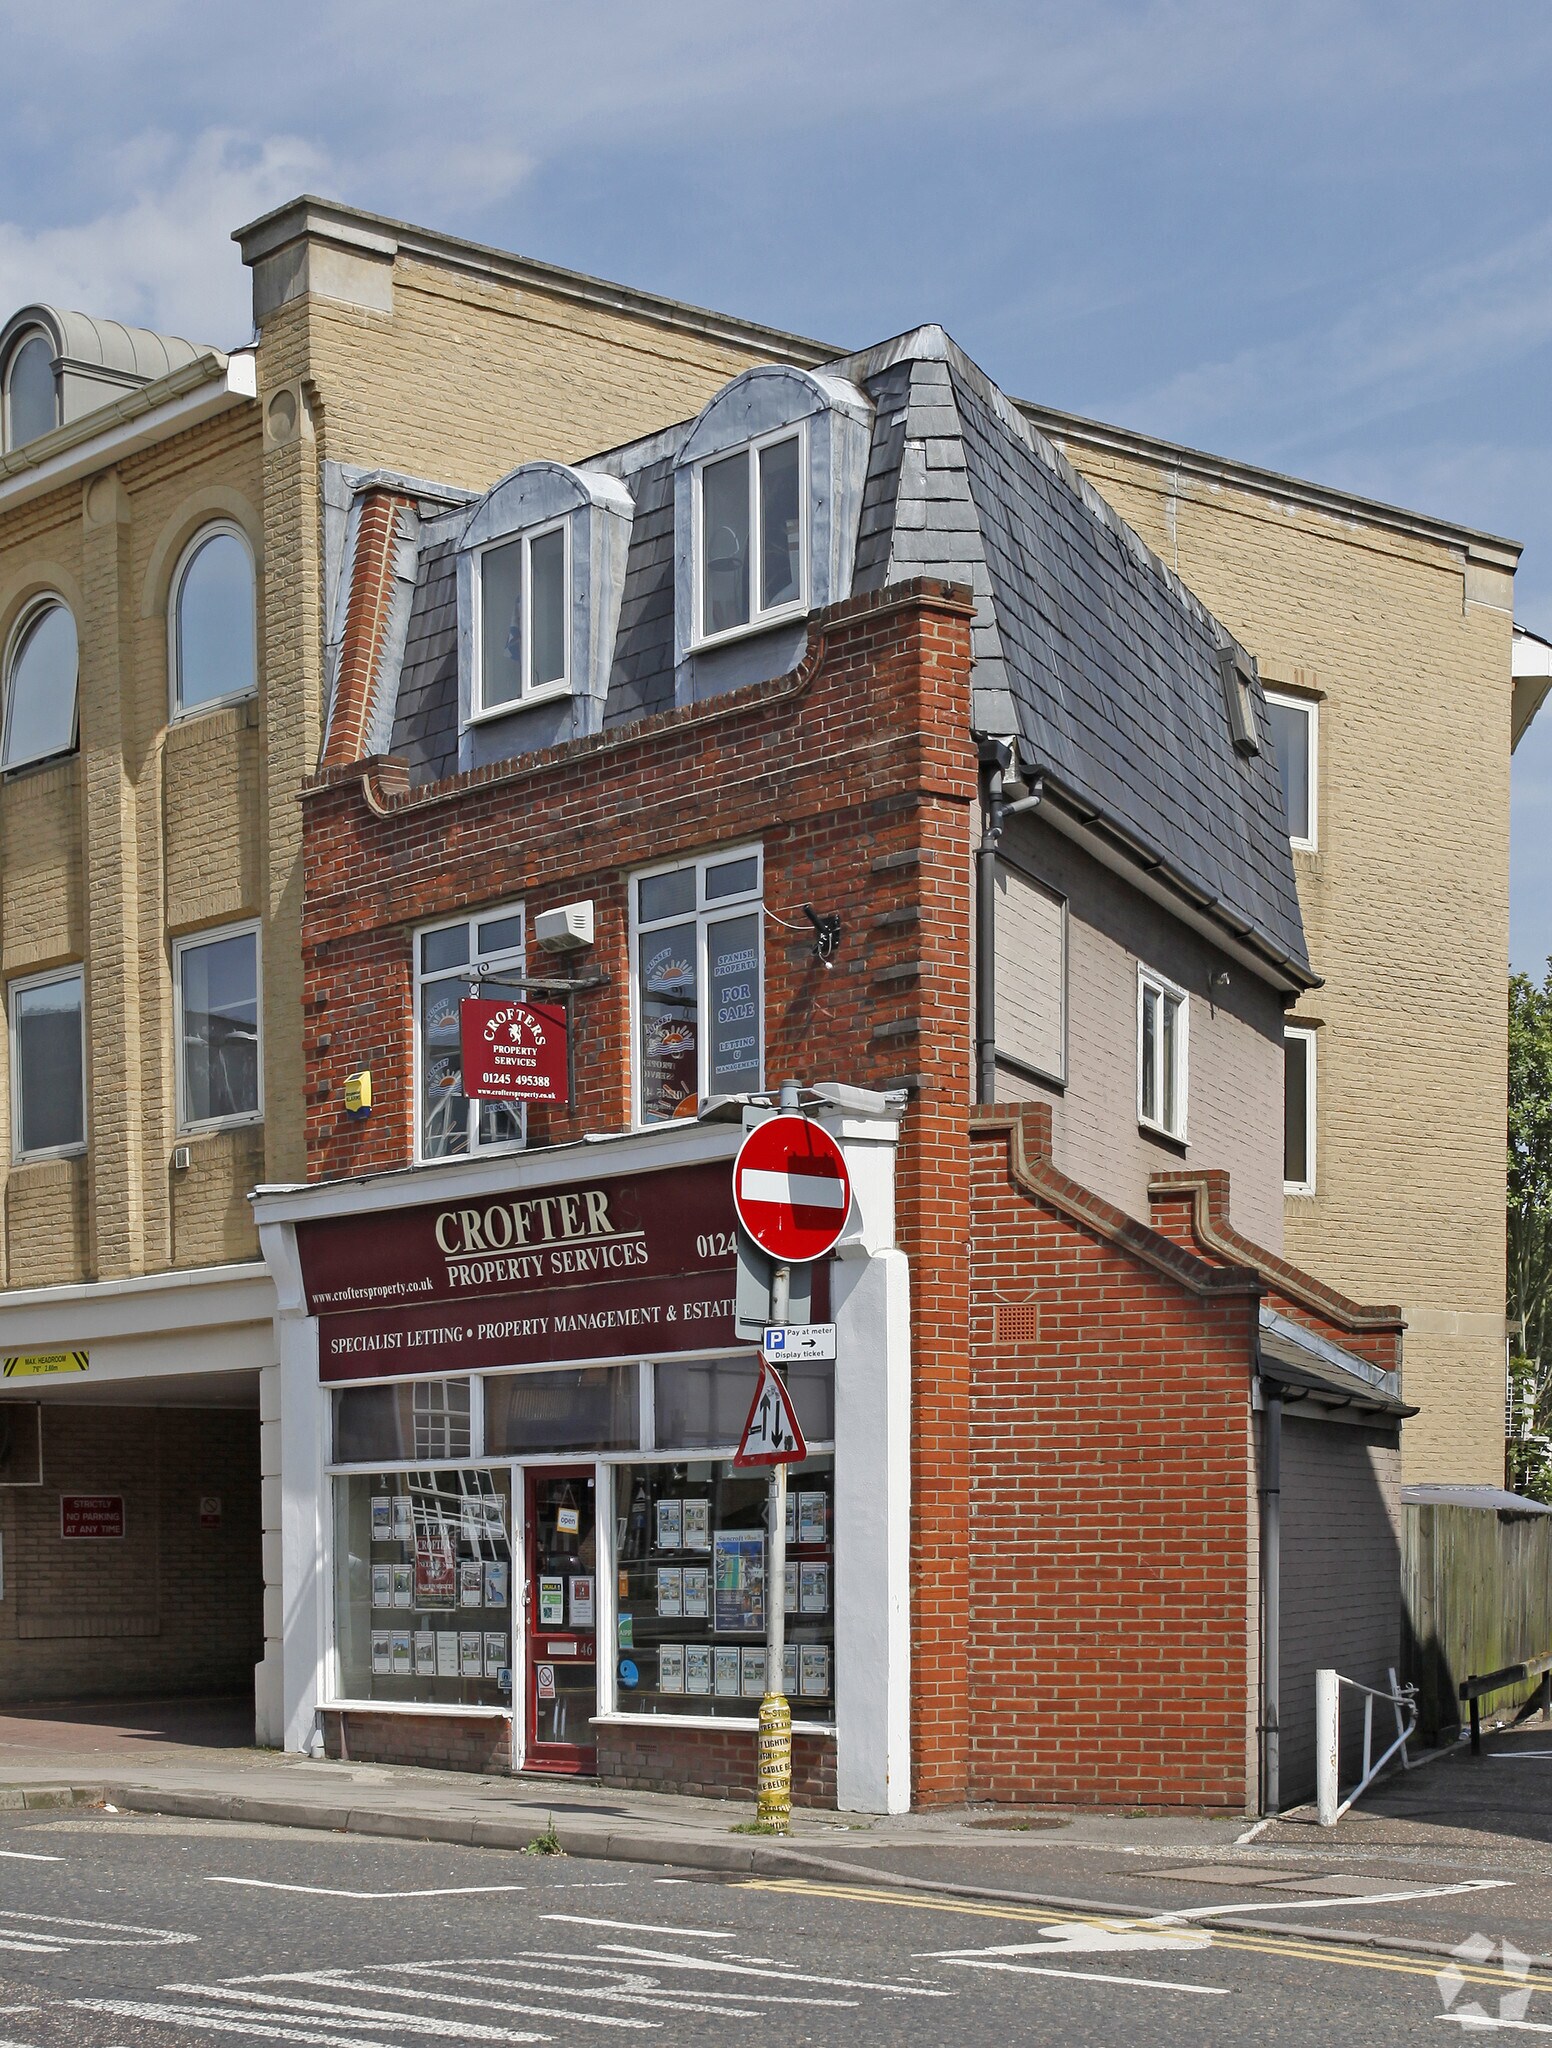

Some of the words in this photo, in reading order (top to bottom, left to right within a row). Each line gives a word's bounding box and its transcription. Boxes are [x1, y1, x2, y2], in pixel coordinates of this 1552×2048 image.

[718, 949, 754, 965] SPANISH
[714, 959, 757, 977] PROPERTY
[722, 984, 750, 1003] FOR
[718, 1003, 755, 1024] SALE
[483, 1008, 546, 1046] CROFTERS
[493, 1044, 538, 1056] PROPERTY
[719, 1036, 755, 1052] LETTING
[494, 1056, 537, 1067] SERVICES
[715, 1060, 759, 1074] MANAGEMENT
[482, 1072, 511, 1084] 01245
[515, 1075, 550, 1087] 495388
[477, 1089, 556, 1099] www.croftersproperty.co.uk
[435, 1190, 615, 1254] CROFTER
[447, 1254, 544, 1288] PROPERTY
[551, 1241, 649, 1275] SERVICES
[312, 1277, 434, 1304] www.croftersproperty.co.uk
[331, 1332, 403, 1354] SPECIALIST
[407, 1327, 463, 1347] LETTING
[477, 1317, 549, 1341] PROPERTY
[554, 1306, 661, 1333] MANAGEMENT
[666, 1305, 677, 1322] &
[775, 1351, 801, 1359] Display
[73, 1500, 111, 1508] STRICTLY
[83, 1513, 120, 1521] PARKING
[560, 1517, 576, 1525] open
[66, 1525, 76, 1533] AT
[80, 1525, 97, 1533] ANY
[101, 1525, 120, 1533] TIME
[580, 1643, 593, 1656] 46
[762, 1764, 784, 1775] CABLE
